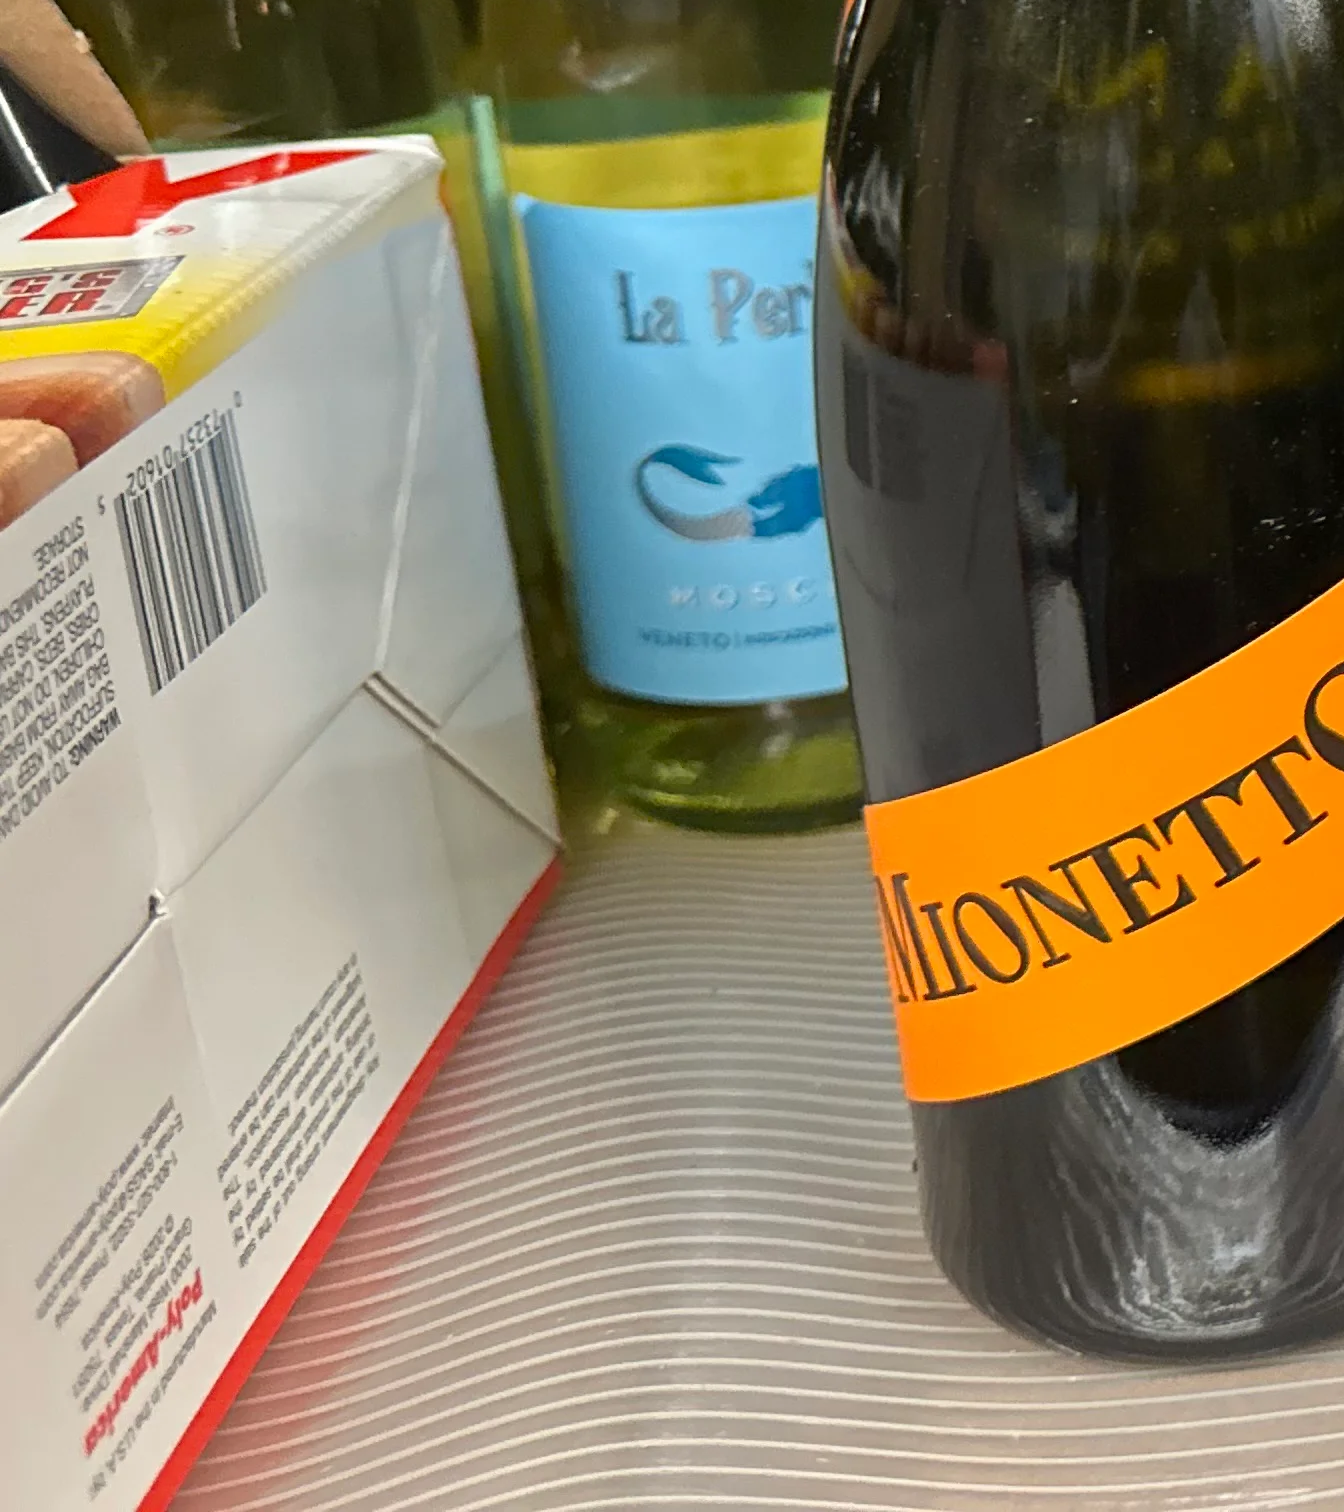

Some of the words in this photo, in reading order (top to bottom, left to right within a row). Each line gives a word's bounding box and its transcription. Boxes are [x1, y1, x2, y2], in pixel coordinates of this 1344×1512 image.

[615, 268, 688, 346] La
[709, 258, 814, 345] Per
[98, 495, 106, 516] 5
[124, 445, 174, 497] 01602
[83, 1267, 203, 1457] Poly-America
